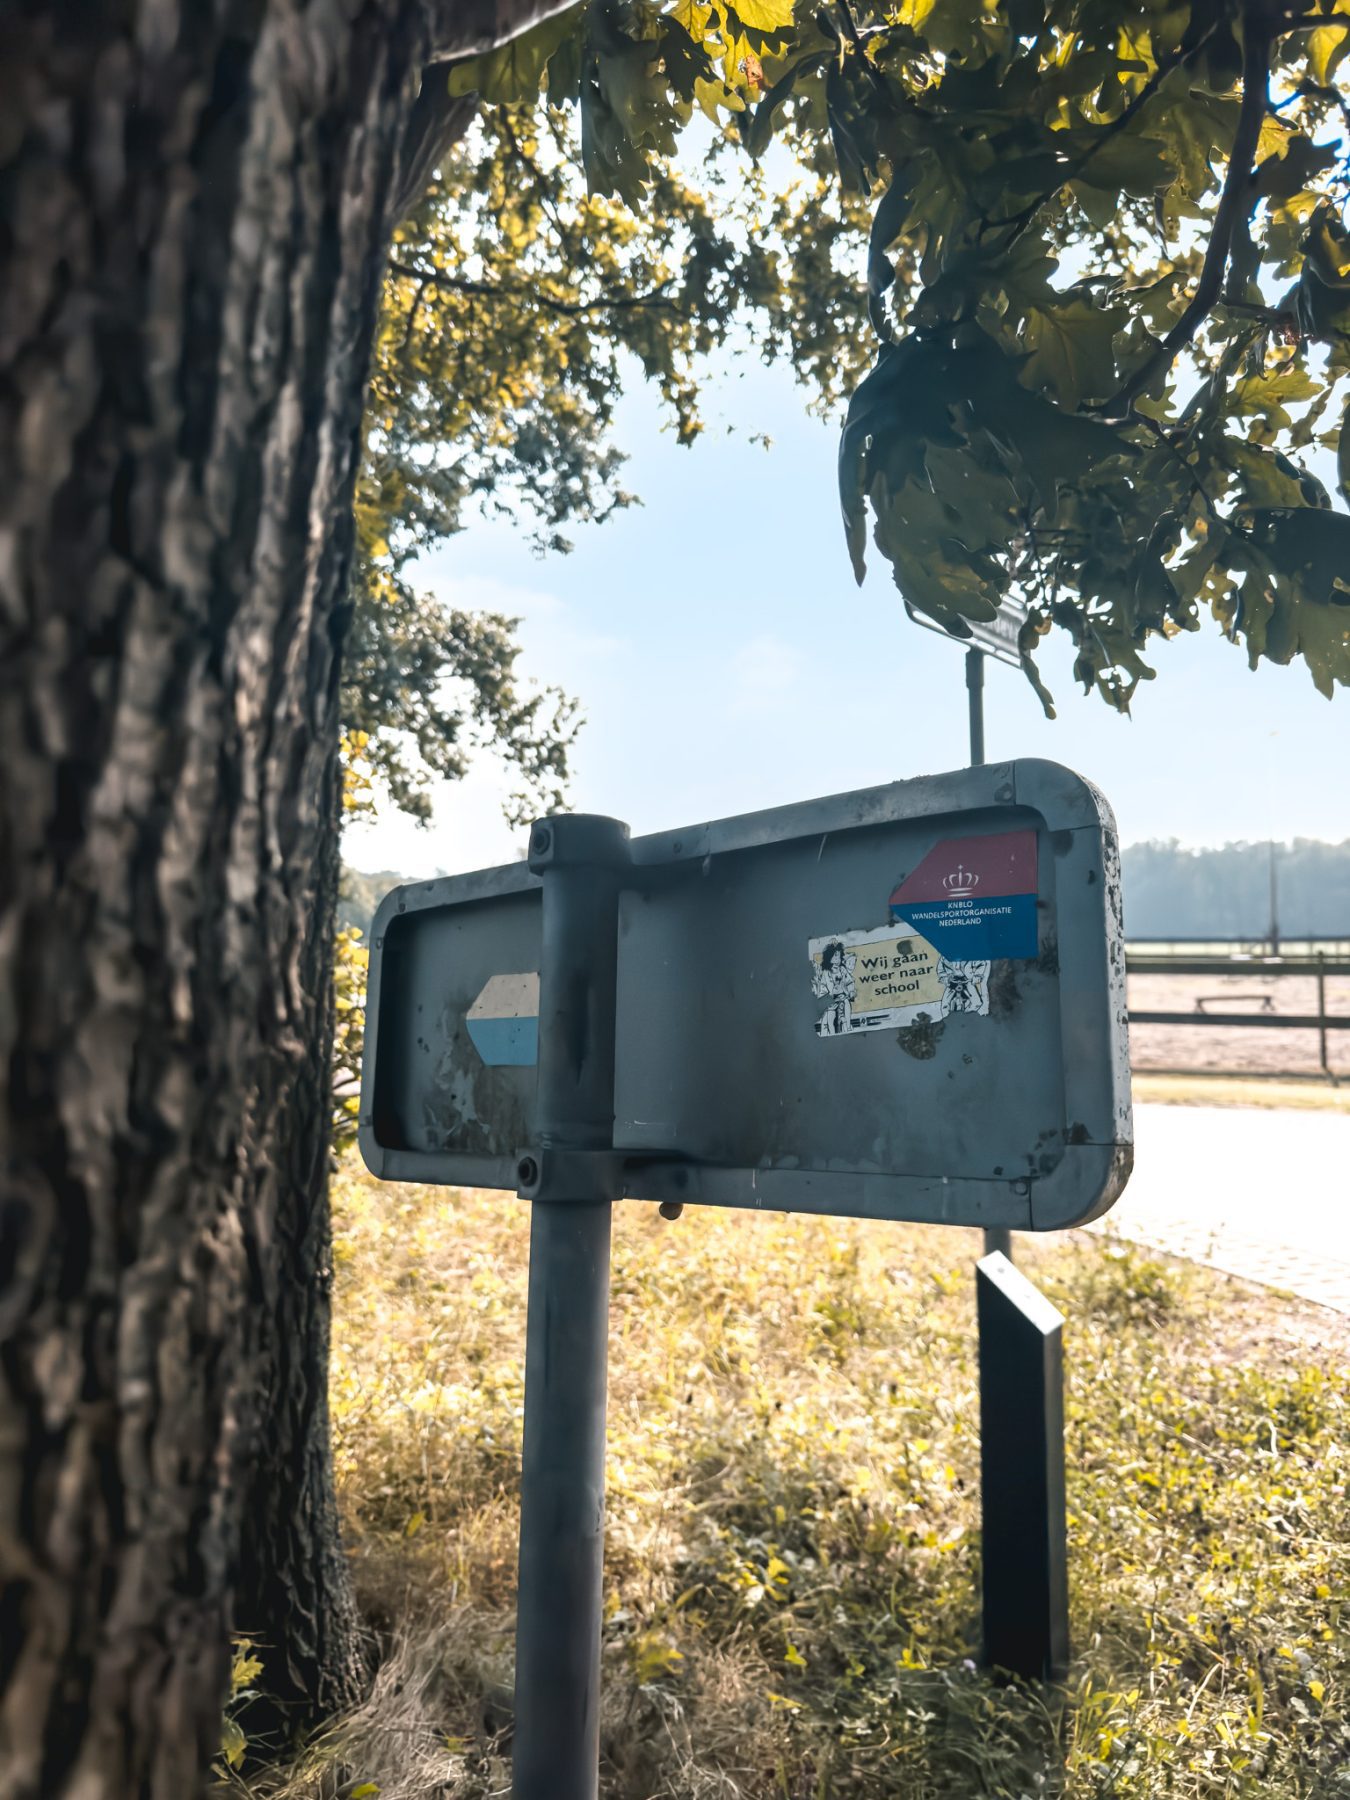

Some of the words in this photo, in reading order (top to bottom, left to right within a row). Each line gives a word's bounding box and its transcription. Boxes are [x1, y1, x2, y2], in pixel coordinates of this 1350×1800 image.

[948, 901, 973, 909] KNBLO
[912, 907, 1012, 920] WANDELSPORTORGANISATIE
[939, 918, 982, 927] NEDERLAND
[861, 957, 888, 970] Wij
[893, 952, 928, 968] gaan
[859, 970, 895, 984] weer
[899, 966, 934, 978] naar
[874, 980, 920, 996] school
